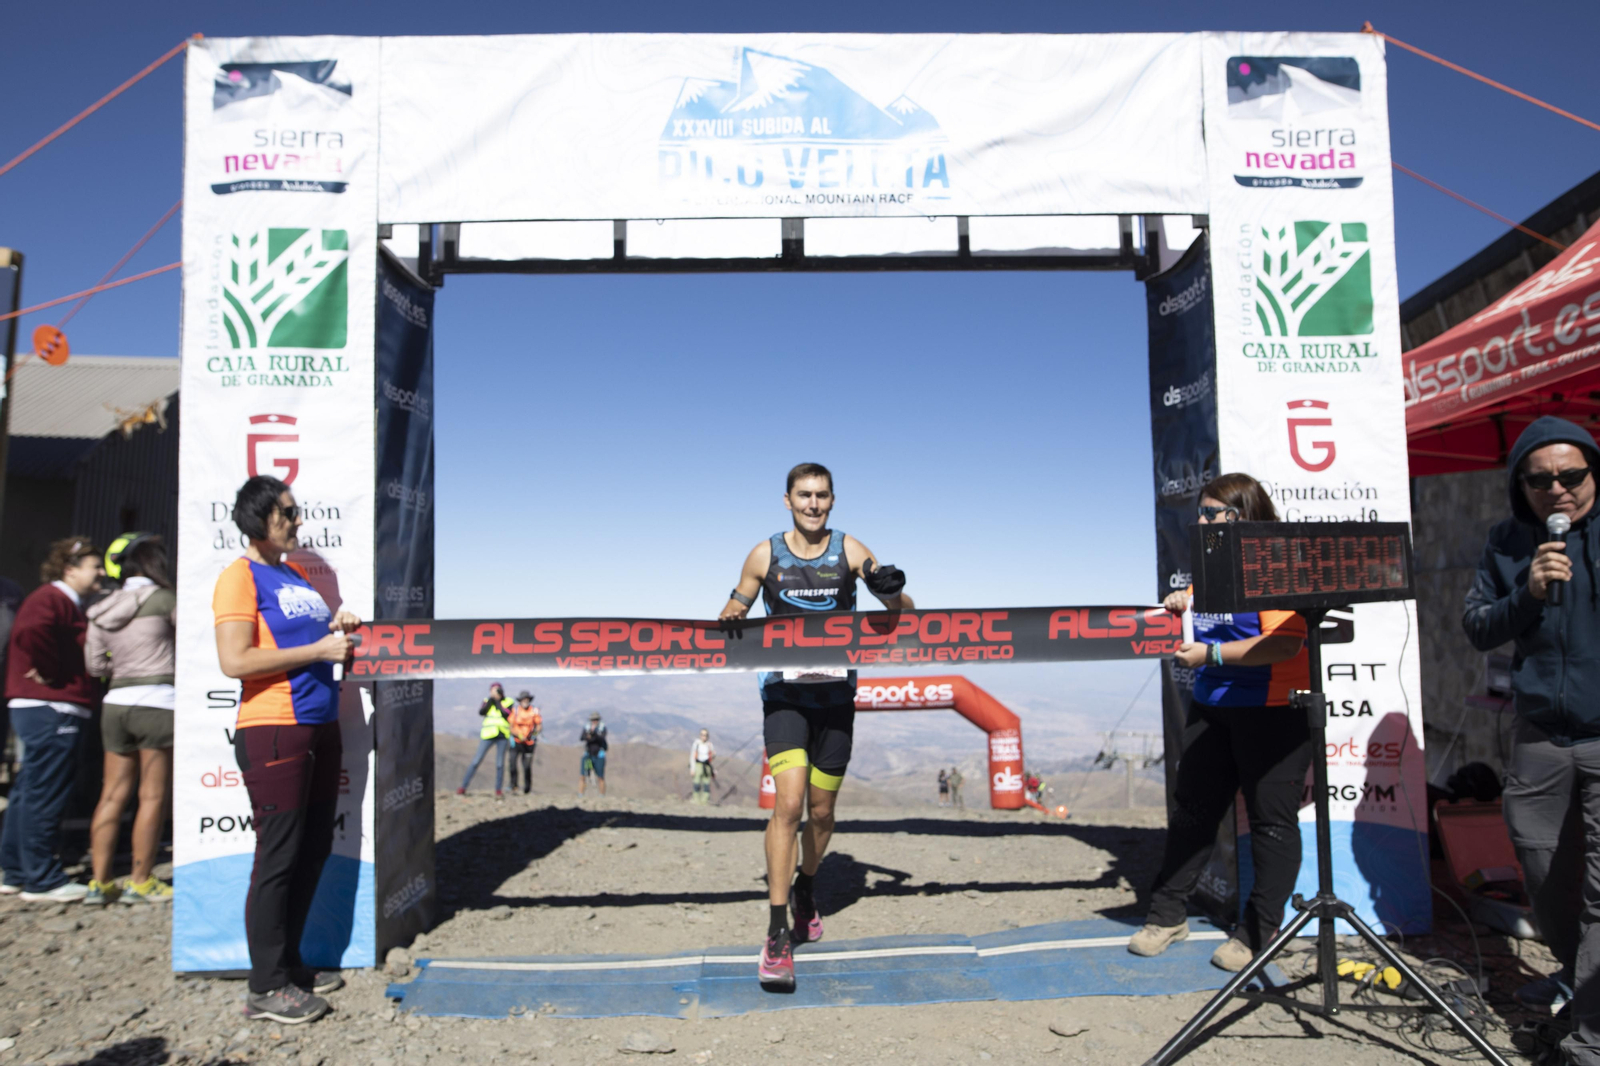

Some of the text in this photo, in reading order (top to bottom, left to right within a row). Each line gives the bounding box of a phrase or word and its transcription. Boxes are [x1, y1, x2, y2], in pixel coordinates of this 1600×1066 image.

[254, 125, 343, 149] sierra
[672, 117, 832, 138] XXXVIII SUBIDA AL
[1271, 124, 1356, 148] sierra
[1245, 148, 1356, 170] nevada
[805, 193, 875, 205] MOUNTAIN
[1237, 223, 1253, 336] fundación
[1242, 342, 1378, 359] CAJA RURAL
[207, 355, 350, 373] CAJA RURAL
[1257, 361, 1362, 373] DE GRANADA
[221, 374, 333, 387] DE GRANADA
[213, 529, 235, 549] de
[762, 611, 1013, 648] ALS SPORT
[1048, 608, 1138, 640] ALS
[352, 624, 434, 657] ORT
[471, 620, 726, 655] ALS SPORT
[556, 653, 727, 671] VISTE TU EVENTO
[846, 645, 1014, 664] VISTE TU EVENTO
[352, 659, 435, 675] EVENTO
[1327, 663, 1386, 681] AT
[853, 680, 954, 708] sport.es
[1326, 737, 1400, 759] ort.es
[1327, 782, 1395, 802] RGYM
